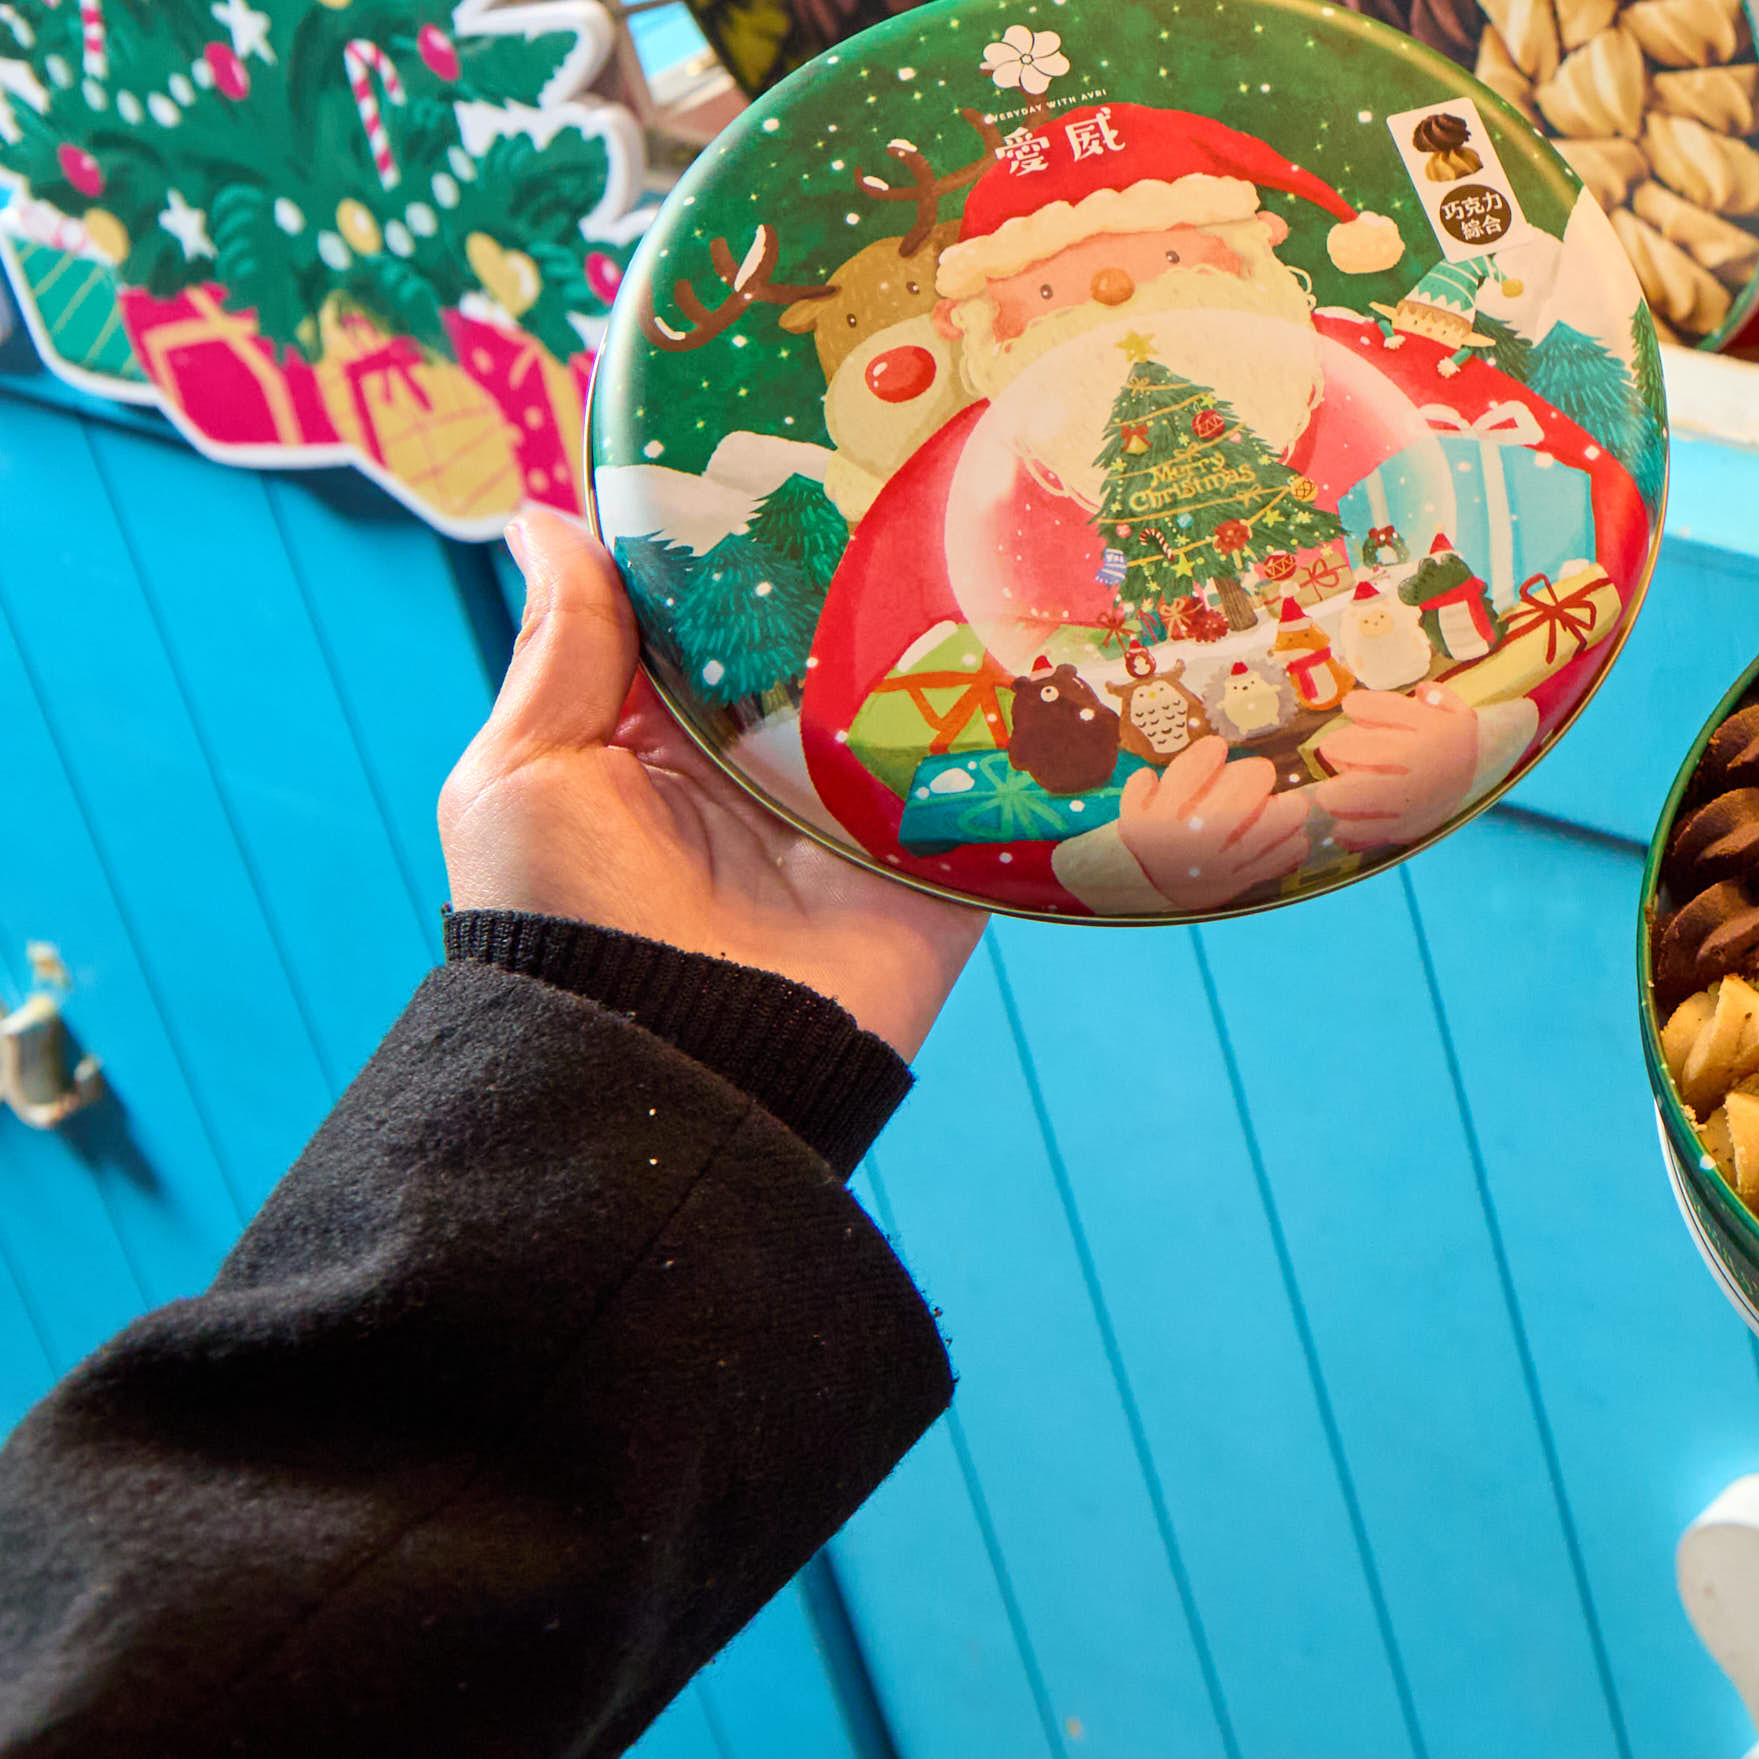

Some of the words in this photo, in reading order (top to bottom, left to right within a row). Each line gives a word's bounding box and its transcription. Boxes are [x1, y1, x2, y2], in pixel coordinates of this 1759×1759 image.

[1046, 96, 1077, 110] WITH
[1081, 88, 1108, 102] AVRI
[994, 106, 1127, 177] 愛威
[1441, 191, 1504, 221] 巧克力
[1460, 213, 1502, 241] 綜合
[1149, 450, 1226, 488] Merry
[1129, 463, 1256, 512] Christmas
